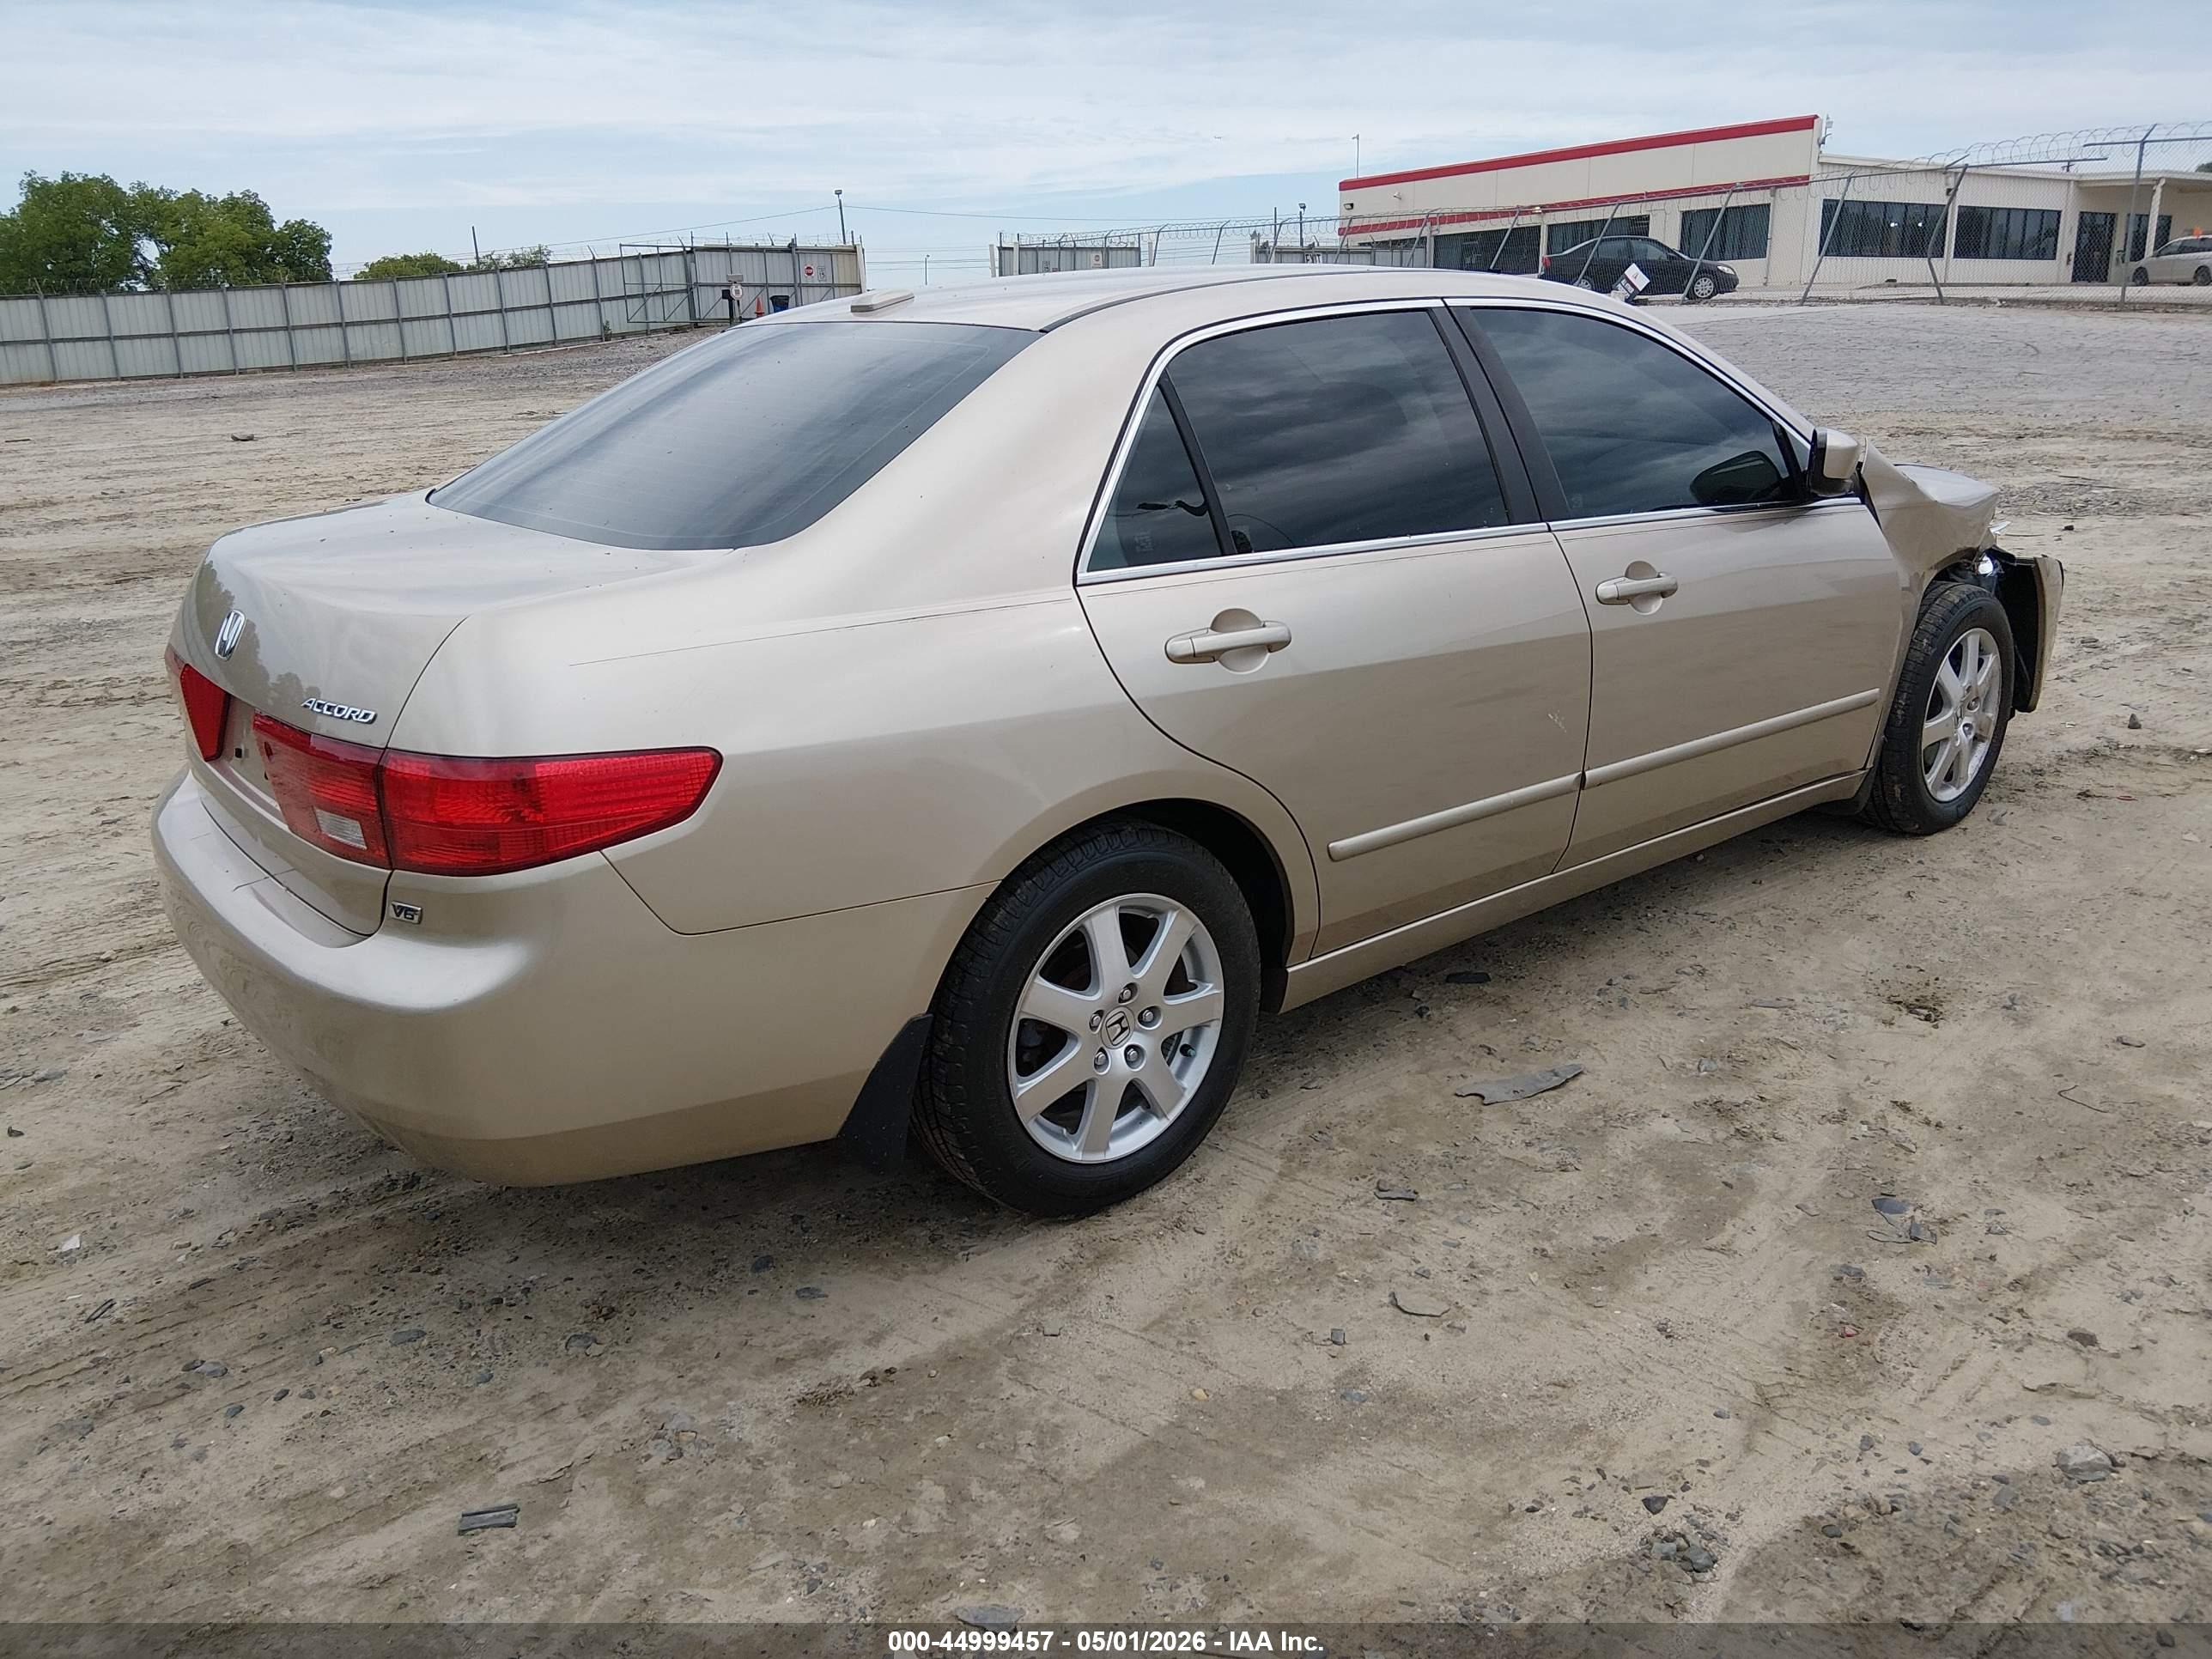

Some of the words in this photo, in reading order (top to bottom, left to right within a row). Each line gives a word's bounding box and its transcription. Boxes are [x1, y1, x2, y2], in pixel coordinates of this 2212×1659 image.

[1305, 253, 1321, 264] EXIT
[301, 697, 377, 724] ACCORD
[392, 903, 416, 921] V6
